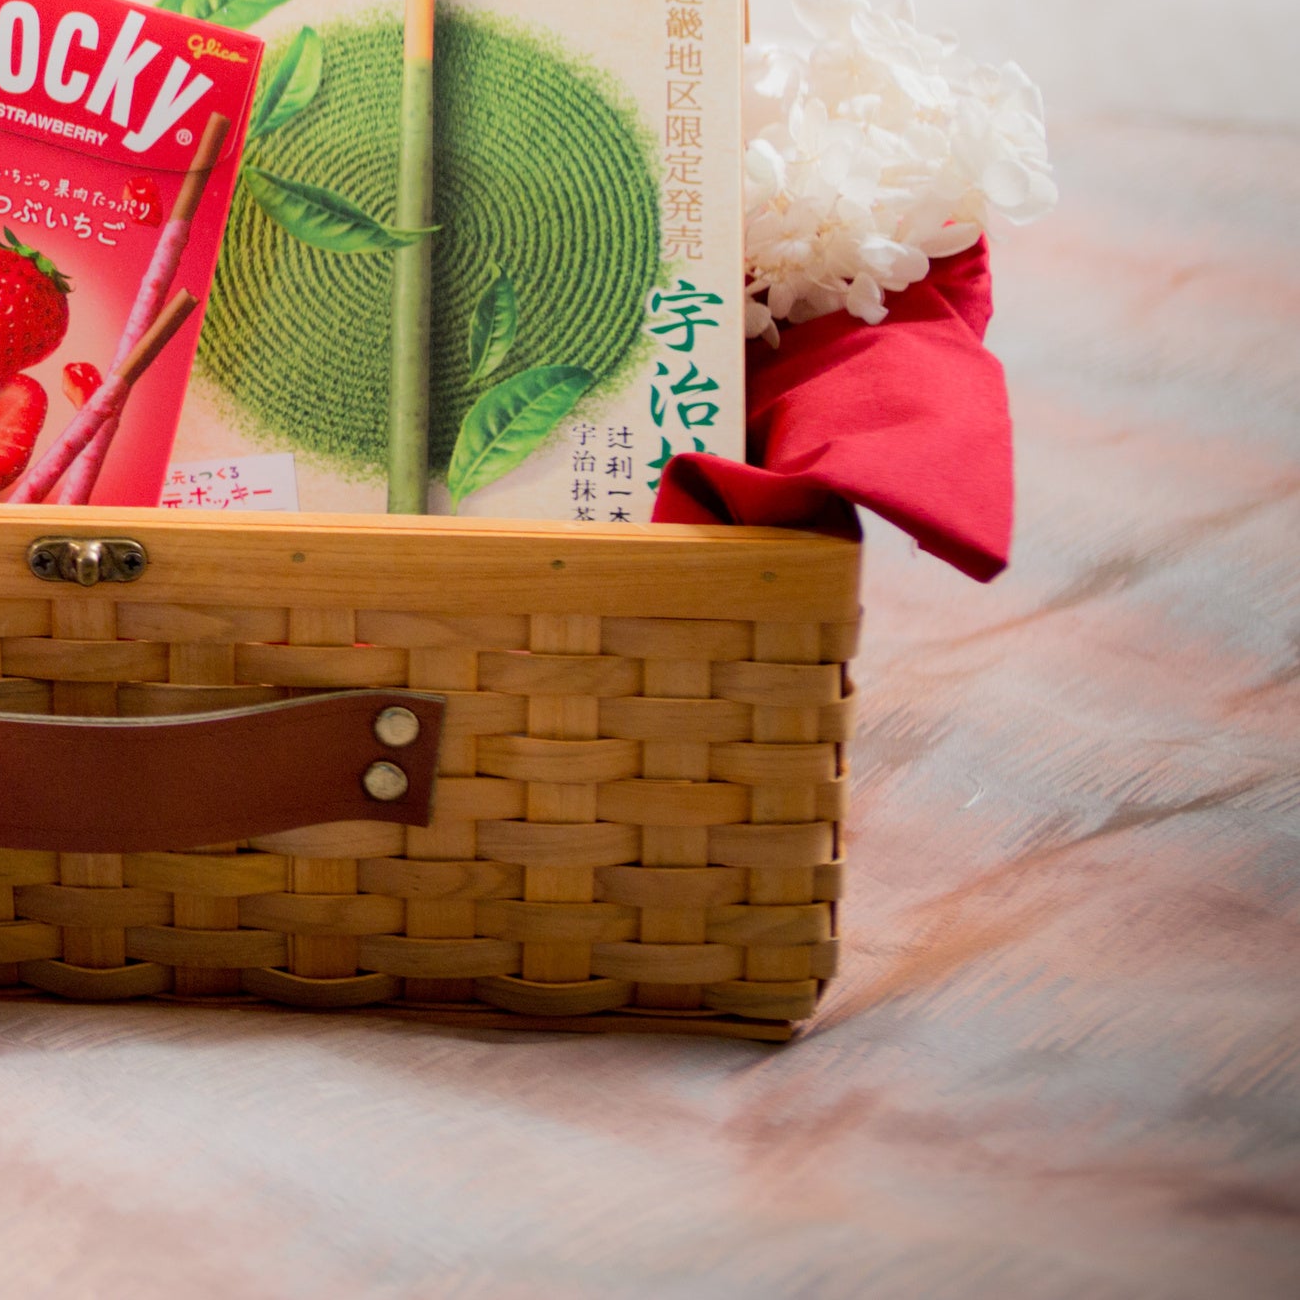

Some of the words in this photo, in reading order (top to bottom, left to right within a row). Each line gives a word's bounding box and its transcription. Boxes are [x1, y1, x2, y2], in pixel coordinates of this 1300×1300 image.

[186, 33, 249, 64] Glico
[164, 465, 240, 487] 元とつくる
